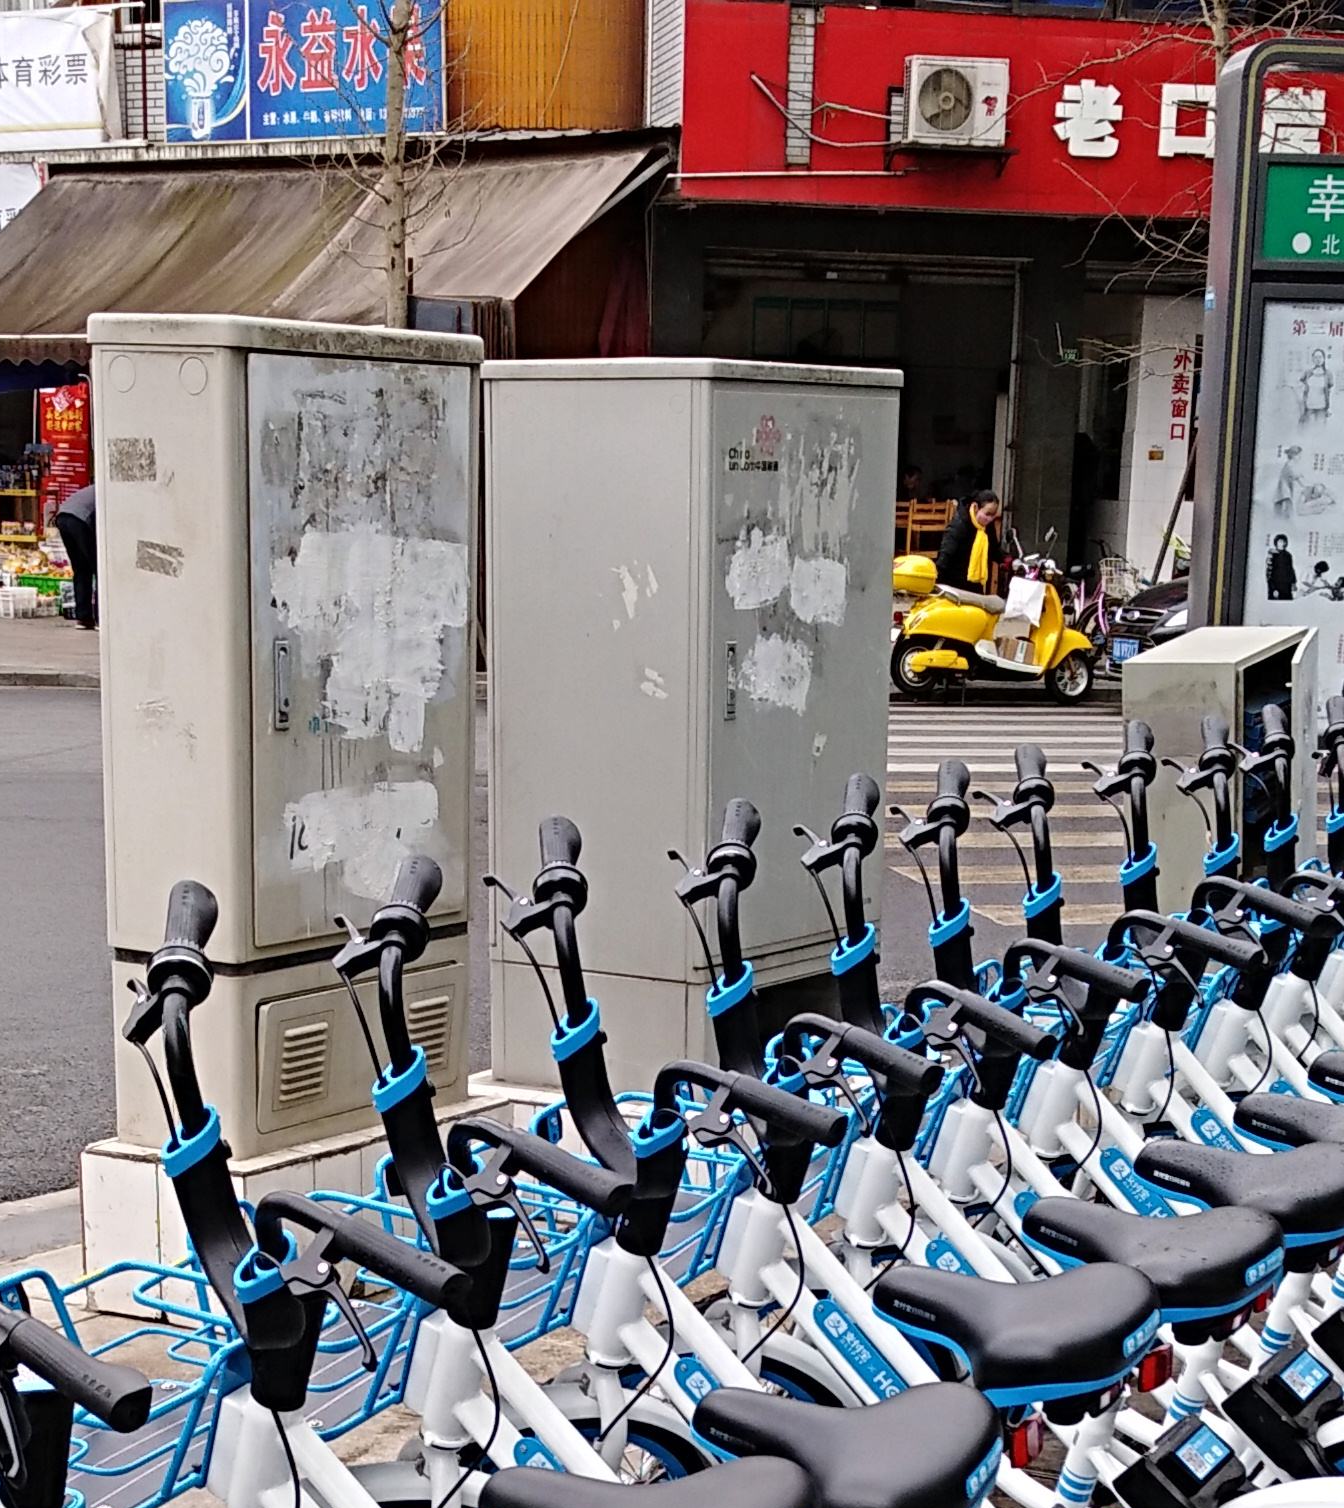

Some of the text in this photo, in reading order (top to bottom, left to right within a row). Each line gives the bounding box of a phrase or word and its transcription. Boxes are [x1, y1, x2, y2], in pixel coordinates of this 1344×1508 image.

[1321, 233, 1341, 255] 北
[1169, 350, 1192, 441] 外卖窗口
